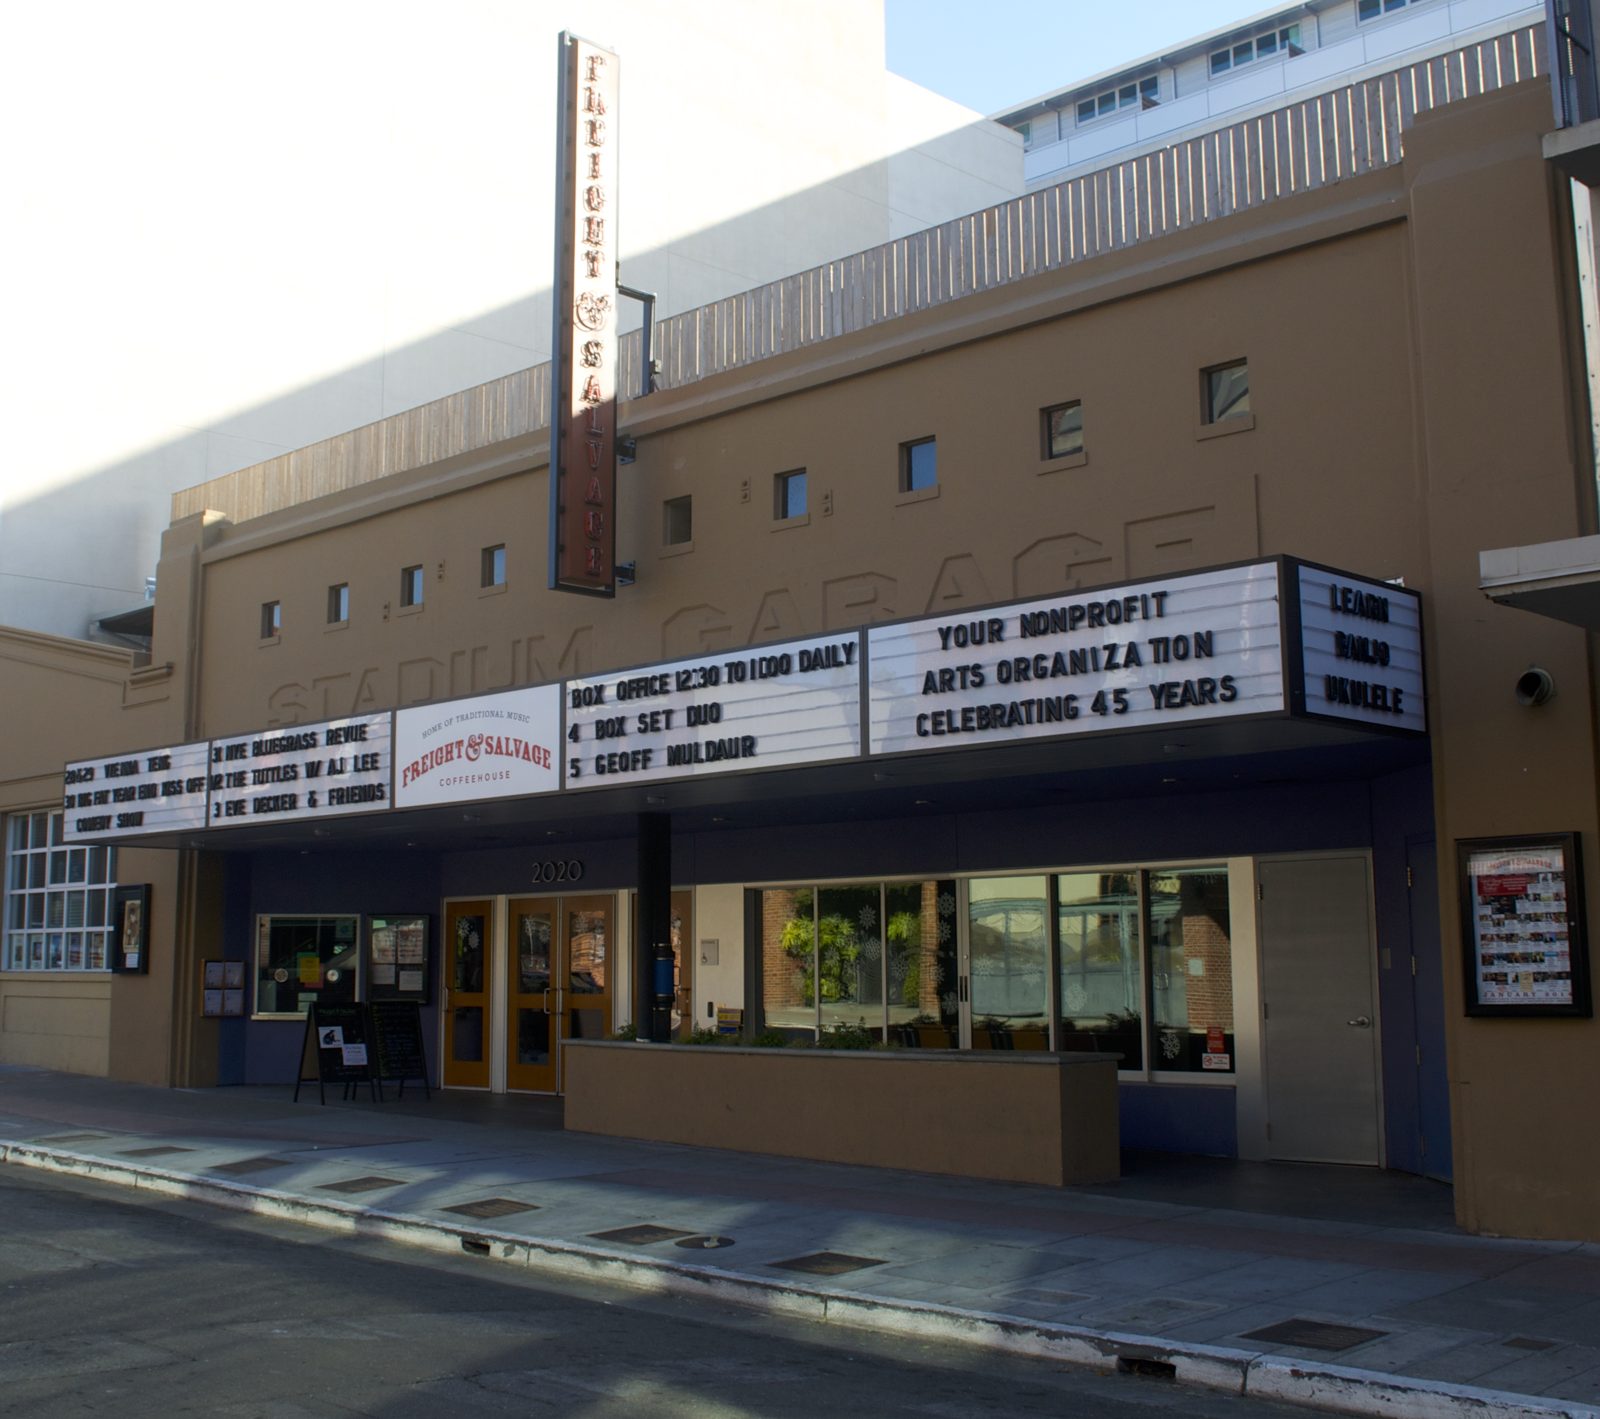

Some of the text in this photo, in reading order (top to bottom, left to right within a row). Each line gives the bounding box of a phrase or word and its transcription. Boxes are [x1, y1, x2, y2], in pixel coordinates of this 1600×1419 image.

[661, 505, 1215, 658] GARAGE
[938, 591, 1169, 651] YOUR NONPROFIT
[1329, 583, 1390, 624] LEARN
[571, 684, 606, 708] BOX
[615, 674, 670, 700] OFFICE
[675, 665, 720, 692] 12:30
[724, 661, 746, 684] TO
[798, 641, 855, 672] DAILY
[922, 630, 1215, 696] ARTS ORGANIZATION
[915, 675, 1238, 737] CELEBRATING 45 YEARS
[1324, 674, 1404, 714] UKULELE
[226, 742, 247, 761] NYE
[252, 731, 318, 757] BLUEGRASS
[326, 723, 368, 746] REVUE
[422, 710, 531, 739] HOME OF TRADITIONAL MUSIC
[568, 702, 721, 743] 4 BOX SET DUO
[226, 771, 247, 788] THE
[252, 764, 298, 785] TUTTLES
[305, 760, 322, 779] W/
[353, 752, 380, 772] LEE
[402, 732, 551, 788] FREIGHT & SALVAGE
[569, 735, 757, 779] 5 GEOFF MULDAUR
[113, 786, 136, 803] YEAR
[162, 779, 183, 796] KISS
[186, 776, 206, 793] OFF
[439, 770, 511, 787] COFFEEHOUSE
[117, 811, 144, 828] SHOW
[213, 782, 386, 818] 3 EVE DECKER & FRIENDS
[531, 859, 584, 884] 2020
